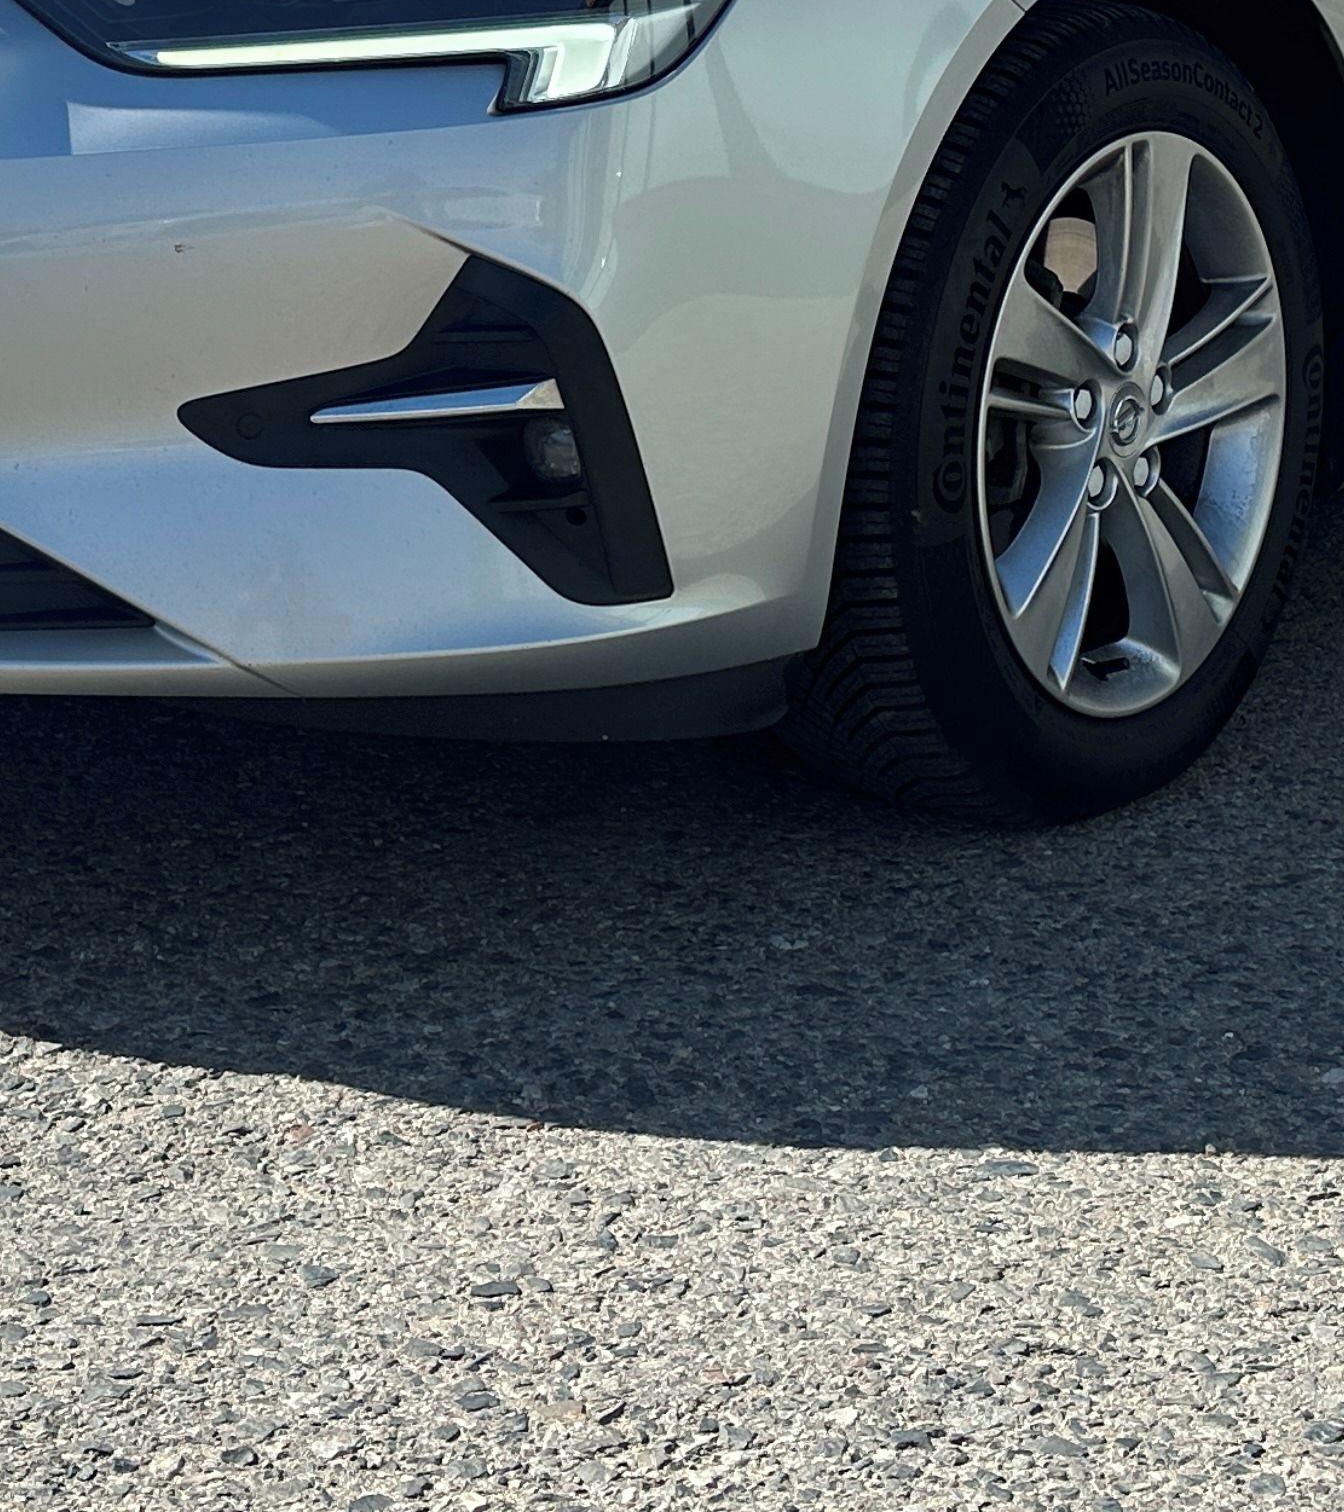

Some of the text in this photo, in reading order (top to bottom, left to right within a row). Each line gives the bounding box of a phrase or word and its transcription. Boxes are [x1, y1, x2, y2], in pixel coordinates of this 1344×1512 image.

[1104, 59, 1265, 141] AllSeasonContact 2
[933, 211, 1014, 514] Continental
